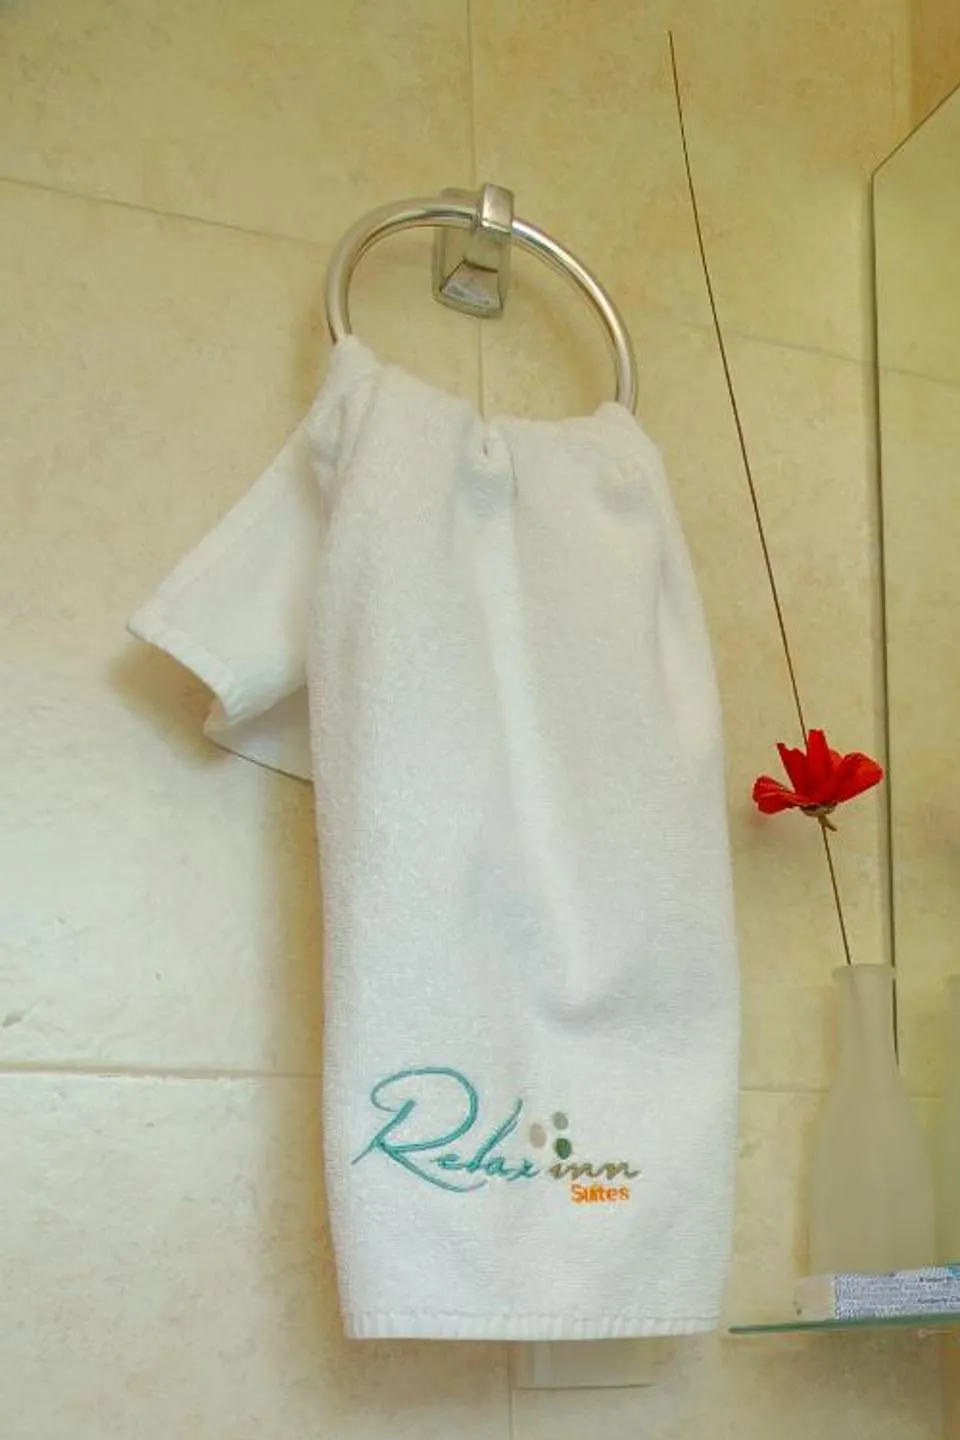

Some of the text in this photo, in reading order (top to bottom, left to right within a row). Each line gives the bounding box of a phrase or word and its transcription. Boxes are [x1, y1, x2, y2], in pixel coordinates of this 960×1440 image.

[350, 1066, 641, 1193] Relax inn
[569, 1183, 630, 1202] Suites
